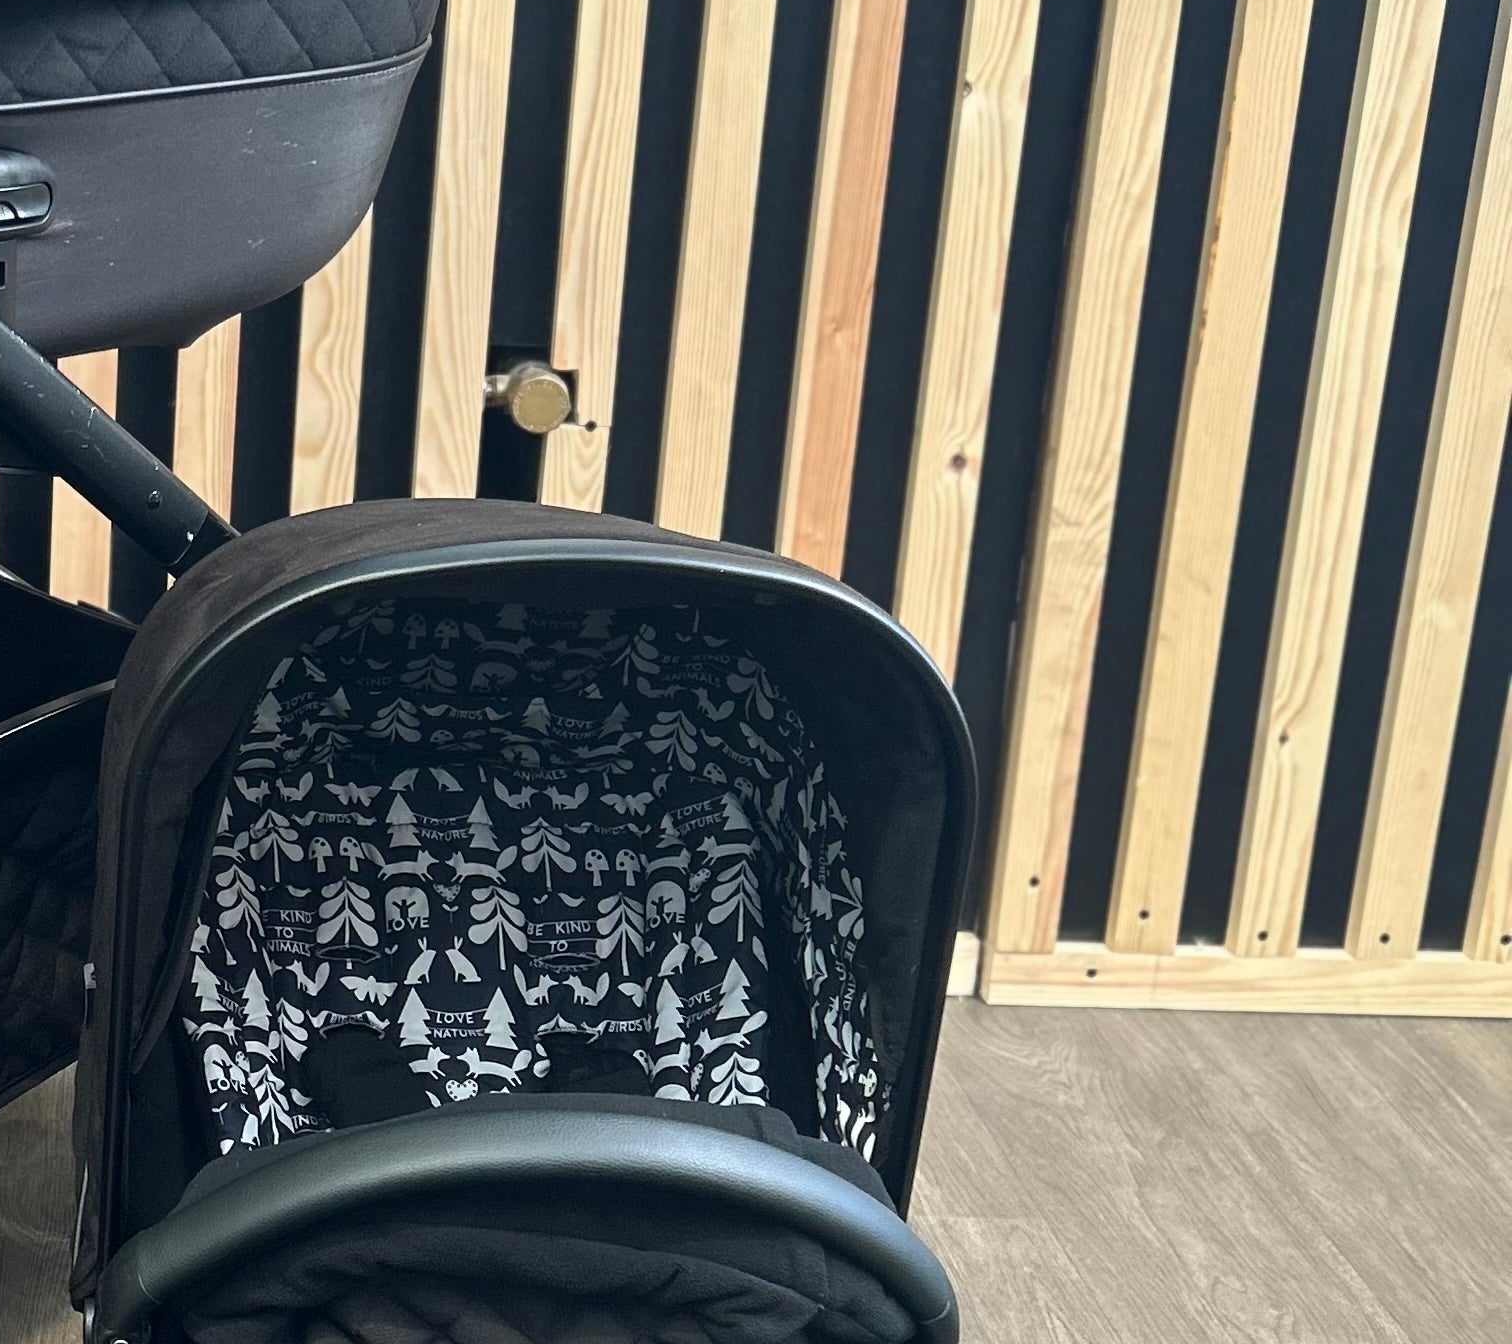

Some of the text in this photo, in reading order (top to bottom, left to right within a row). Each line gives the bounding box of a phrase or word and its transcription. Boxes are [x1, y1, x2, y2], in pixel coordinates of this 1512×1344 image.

[676, 799, 713, 820] LOVE
[420, 829, 470, 843] NATURE
[279, 910, 313, 925] KIND
[385, 916, 431, 934] LOVE
[526, 921, 592, 937] BE KIND
[274, 926, 295, 939] TO
[265, 941, 312, 958] NIMALS
[549, 940, 569, 953] TO
[435, 1011, 476, 1025] LOVE
[433, 1027, 486, 1039] NATURE
[606, 1019, 645, 1033] BIRDS
[291, 1115, 319, 1130] IND
